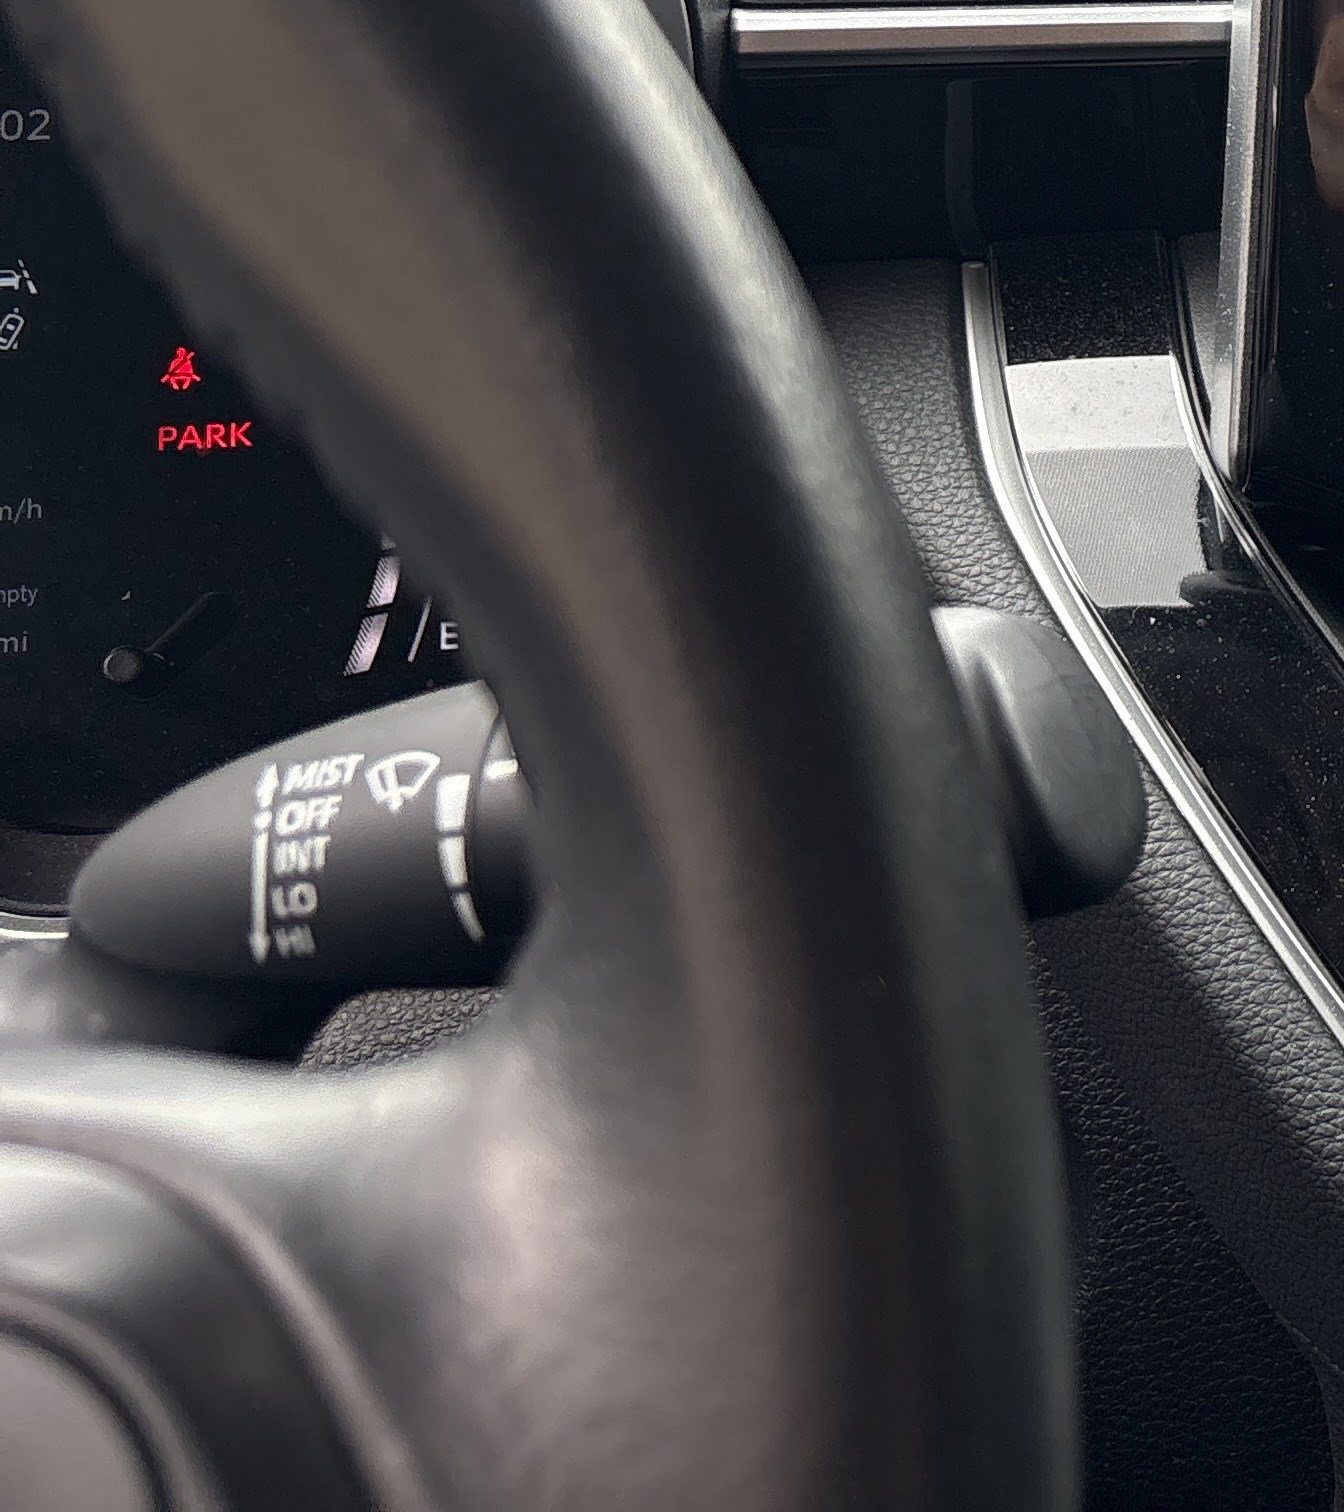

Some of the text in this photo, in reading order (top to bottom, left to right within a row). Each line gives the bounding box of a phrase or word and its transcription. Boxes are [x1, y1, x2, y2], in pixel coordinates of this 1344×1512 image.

[0, 109, 51, 141] 02
[157, 421, 253, 451] PARK
[440, 622, 458, 650] E
[280, 751, 365, 796] MIST
[273, 794, 342, 836] OFF
[272, 835, 331, 876] INT
